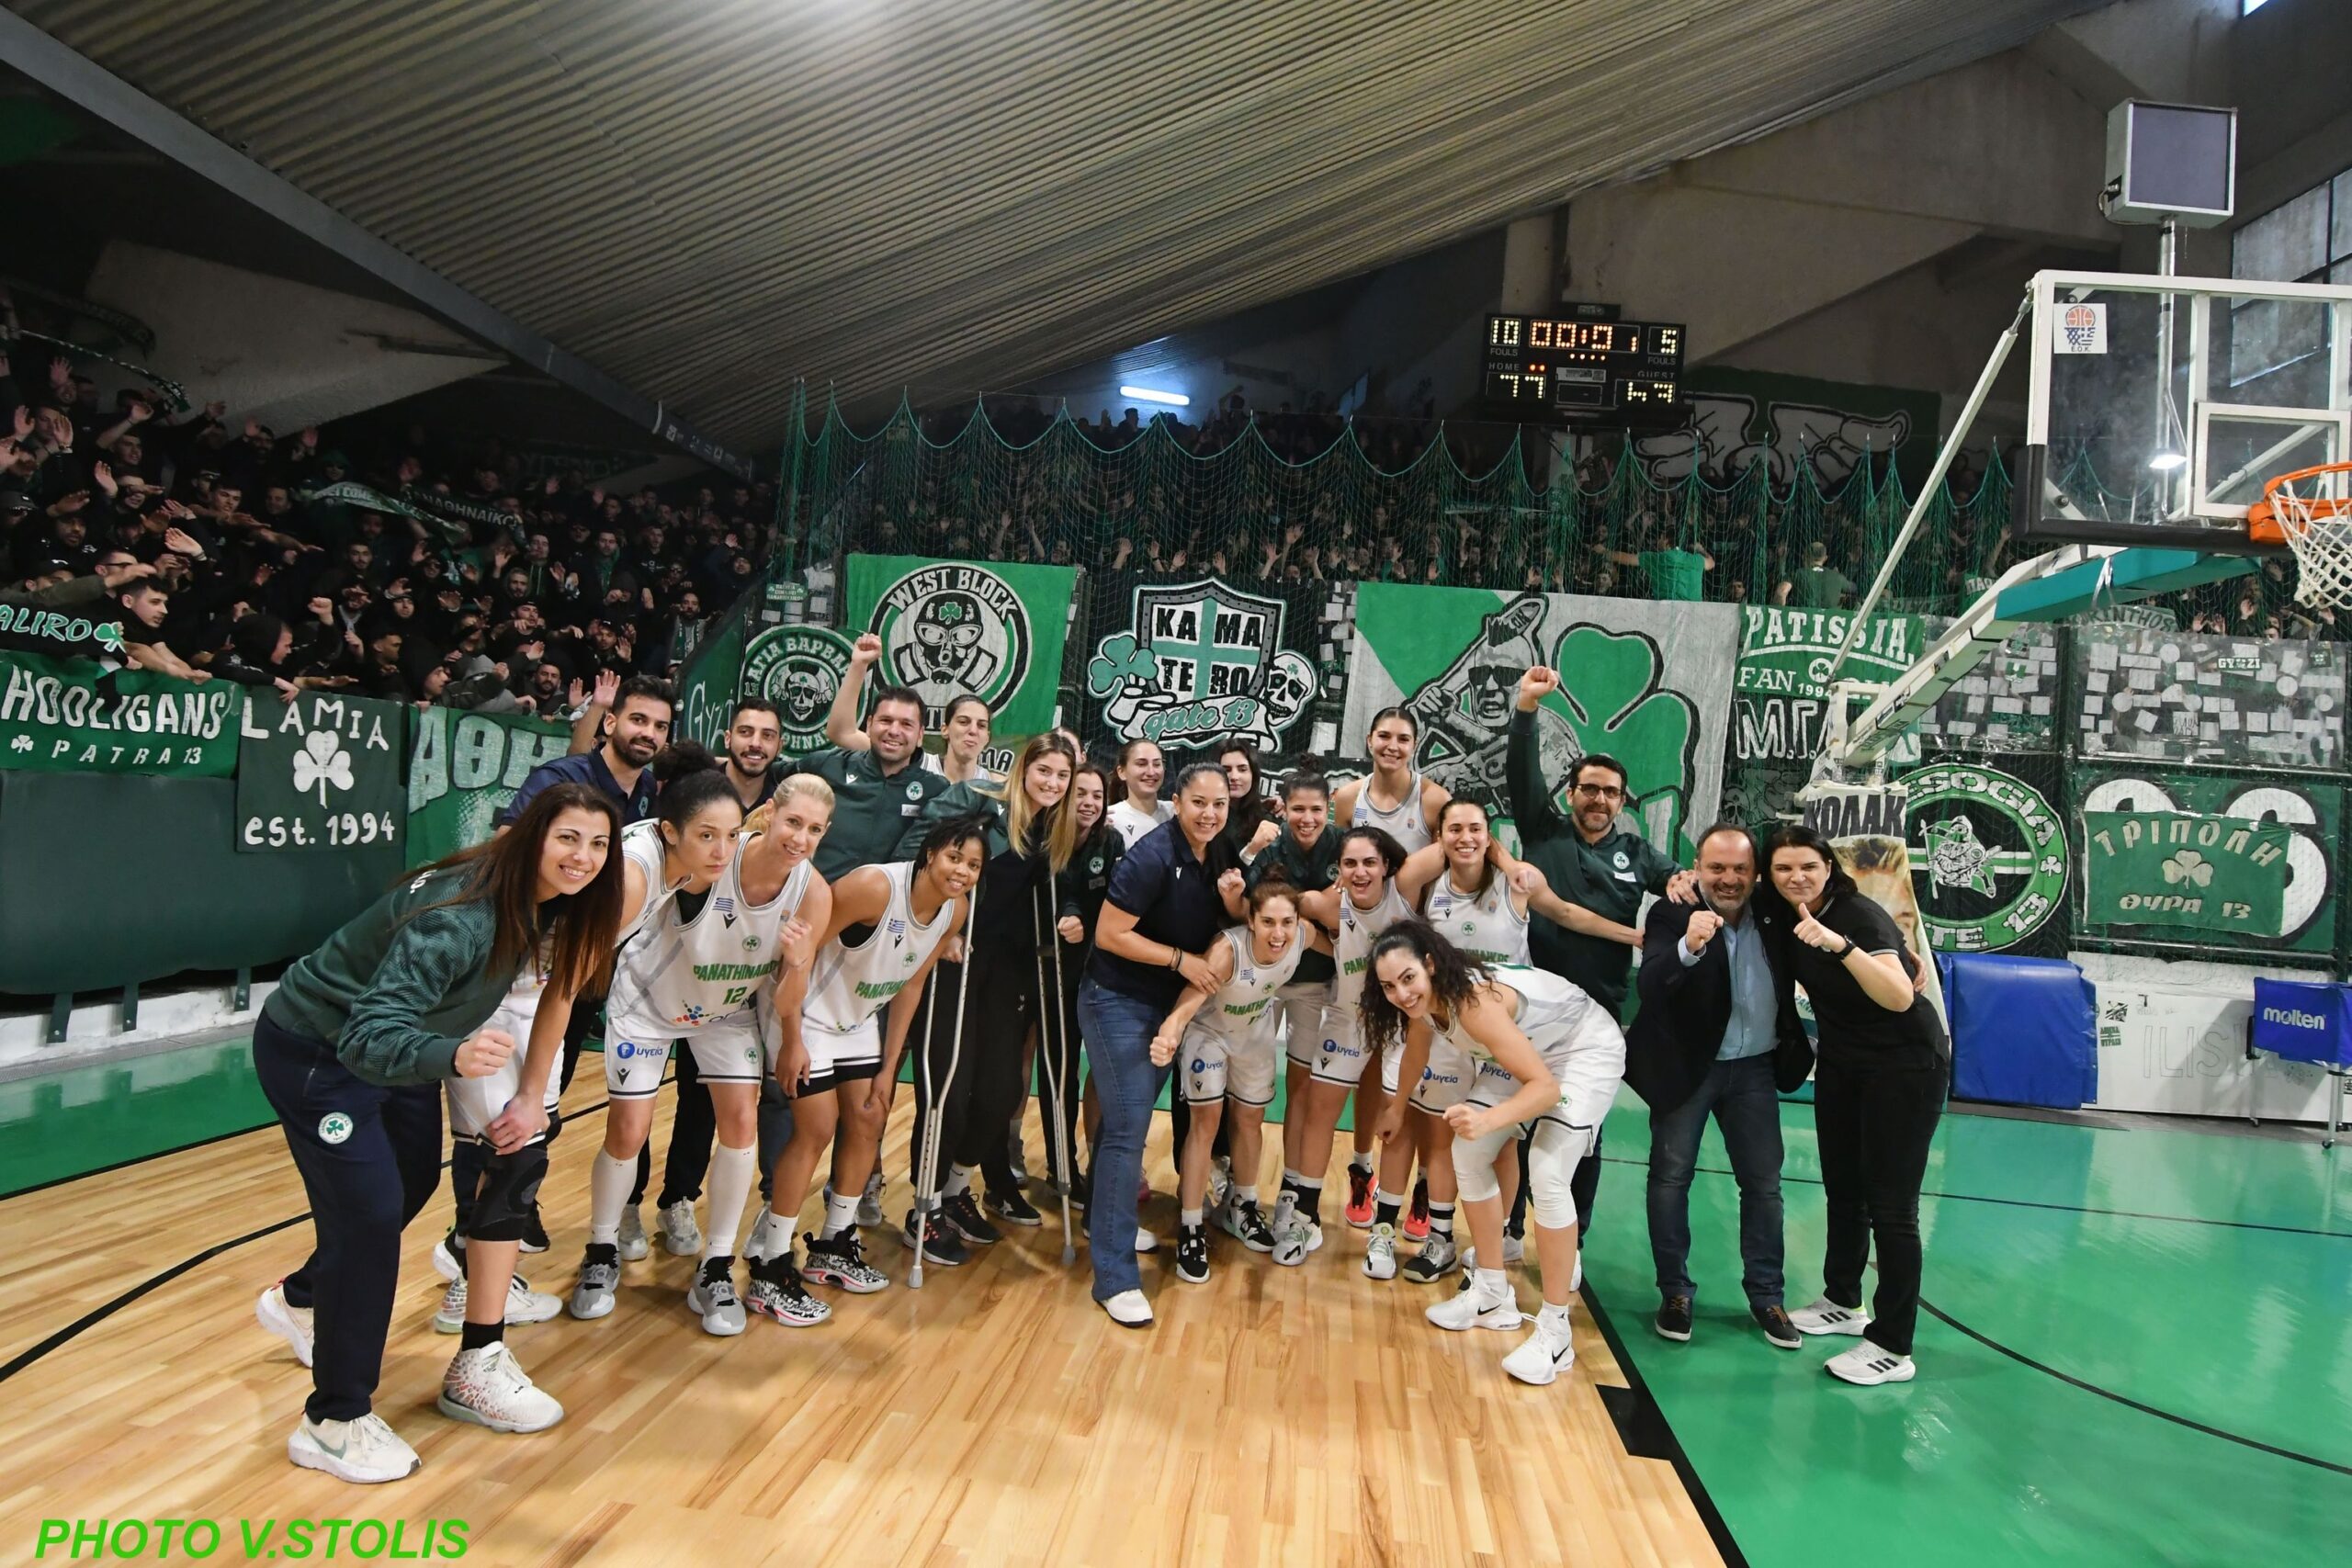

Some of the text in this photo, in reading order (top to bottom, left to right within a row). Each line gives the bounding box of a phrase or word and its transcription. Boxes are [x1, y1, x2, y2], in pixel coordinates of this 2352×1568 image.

[1489, 347, 1519, 357] FOULS
[1647, 355, 1677, 367] FOULS
[1488, 362, 1521, 372] HOME
[1637, 369, 1676, 379] GUEST
[888, 568, 1020, 626] WEST BLOCK
[1746, 605, 1907, 662] PATISSIA
[1737, 667, 1797, 692] FAN
[1, 664, 227, 739] HOOLIGANS
[241, 697, 390, 752] LAMIA
[1145, 698, 1259, 739] gate 13
[51, 739, 202, 765] PATRA 13
[244, 812, 395, 847] est. 1994
[2094, 819, 2283, 868] ΤΡΙΠΟΛΗ
[2119, 893, 2252, 919] ΘΥΡΑ 13
[723, 987, 748, 1005] 12
[2263, 1007, 2325, 1030] molten
